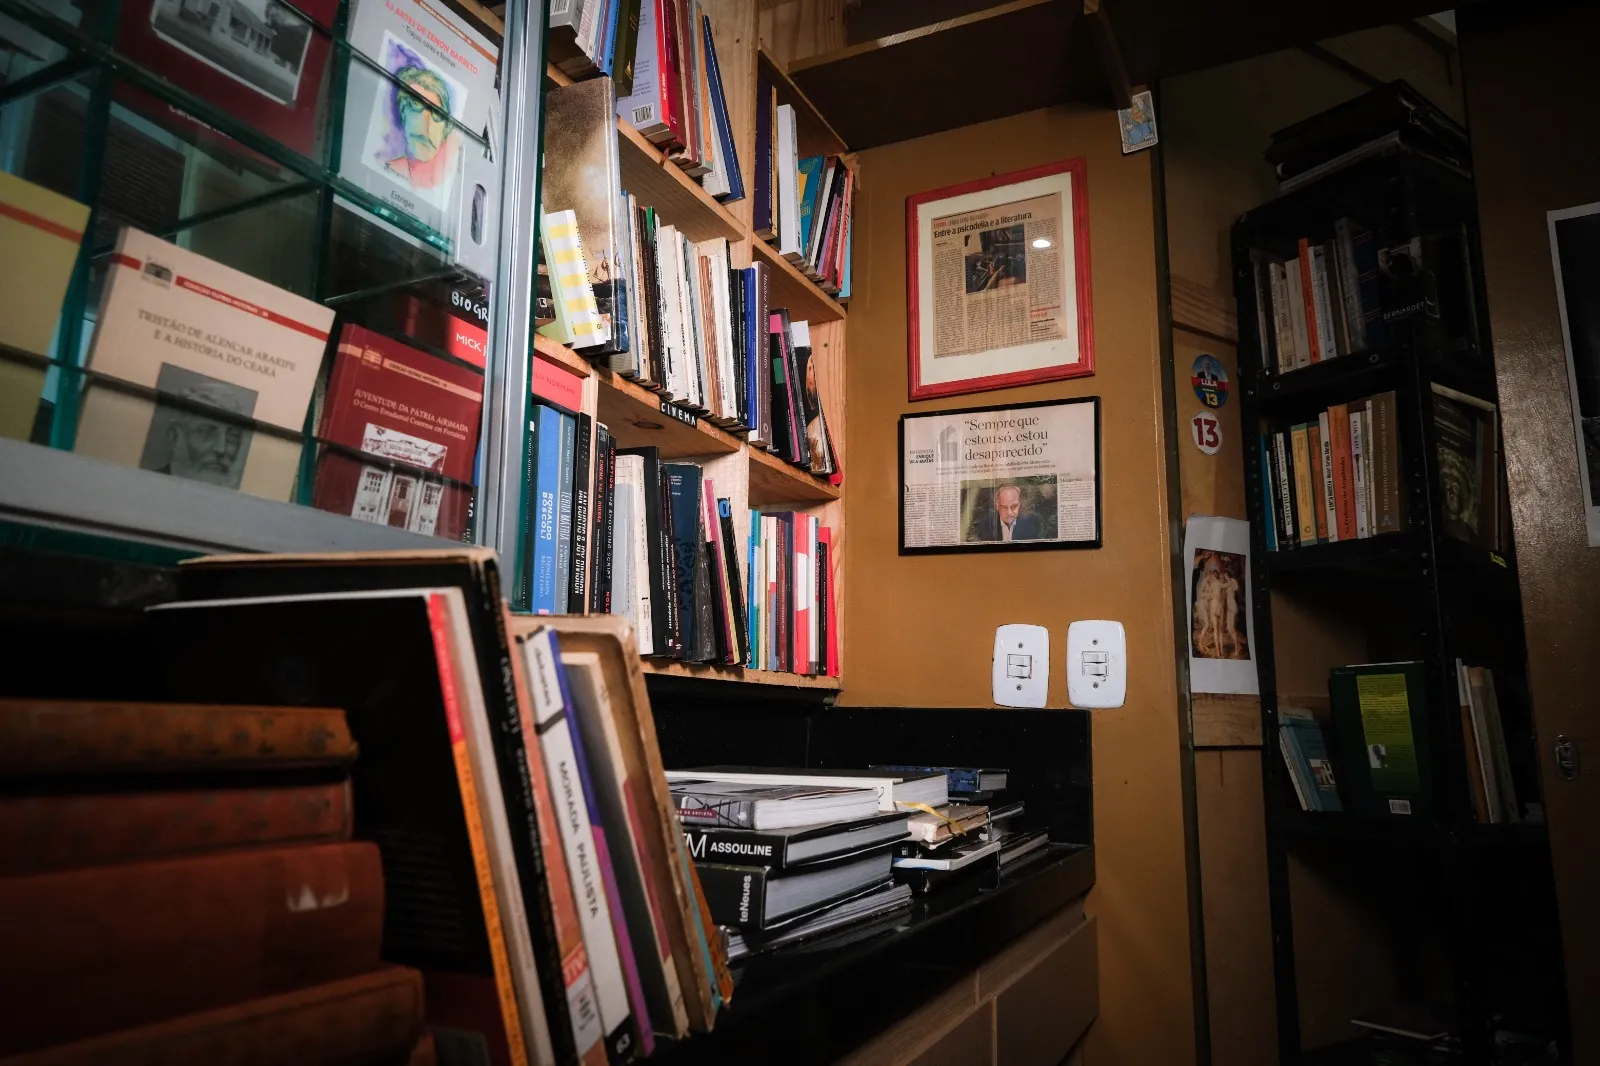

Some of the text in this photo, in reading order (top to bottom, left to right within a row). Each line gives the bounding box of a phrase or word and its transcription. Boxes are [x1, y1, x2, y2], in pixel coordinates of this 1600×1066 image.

[426, 30, 450, 53] ZENON
[447, 47, 479, 75] BARRETO
[391, 190, 415, 210] Estrigas
[934, 229, 952, 238] Entre
[957, 220, 989, 234] psicodelia
[1000, 212, 1032, 224] literatura
[1382, 300, 1425, 320] BERNARDET
[138, 308, 298, 372] TRISTÃO DE ALENCAR ARARIPE
[154, 329, 160, 340] E
[163, 332, 172, 344] A
[174, 335, 224, 361] HISTÓRIA
[226, 354, 242, 368] DO
[456, 332, 482, 352] MICK
[1200, 378, 1218, 388] LULA
[354, 389, 398, 410] JUVENTUDE
[398, 403, 408, 414] DA
[410, 405, 436, 422] PÁTRIA
[1205, 392, 1218, 406] 13
[360, 401, 380, 413] Centro
[410, 417, 434, 430] Cearense
[443, 427, 466, 440] Fortaleza
[660, 402, 696, 426] CINEMA
[1016, 416, 1040, 430] que
[964, 434, 998, 446] estou
[1016, 430, 1048, 442] estou
[1193, 418, 1219, 448] 13
[560, 491, 572, 540] TERRA MÁTRIA
[576, 542, 586, 558] JOY
[574, 559, 585, 594] DIVISION
[558, 761, 600, 920] MORADA PAULISTA
[710, 842, 772, 856] ASSOULINE
[740, 875, 752, 922] teNeues
